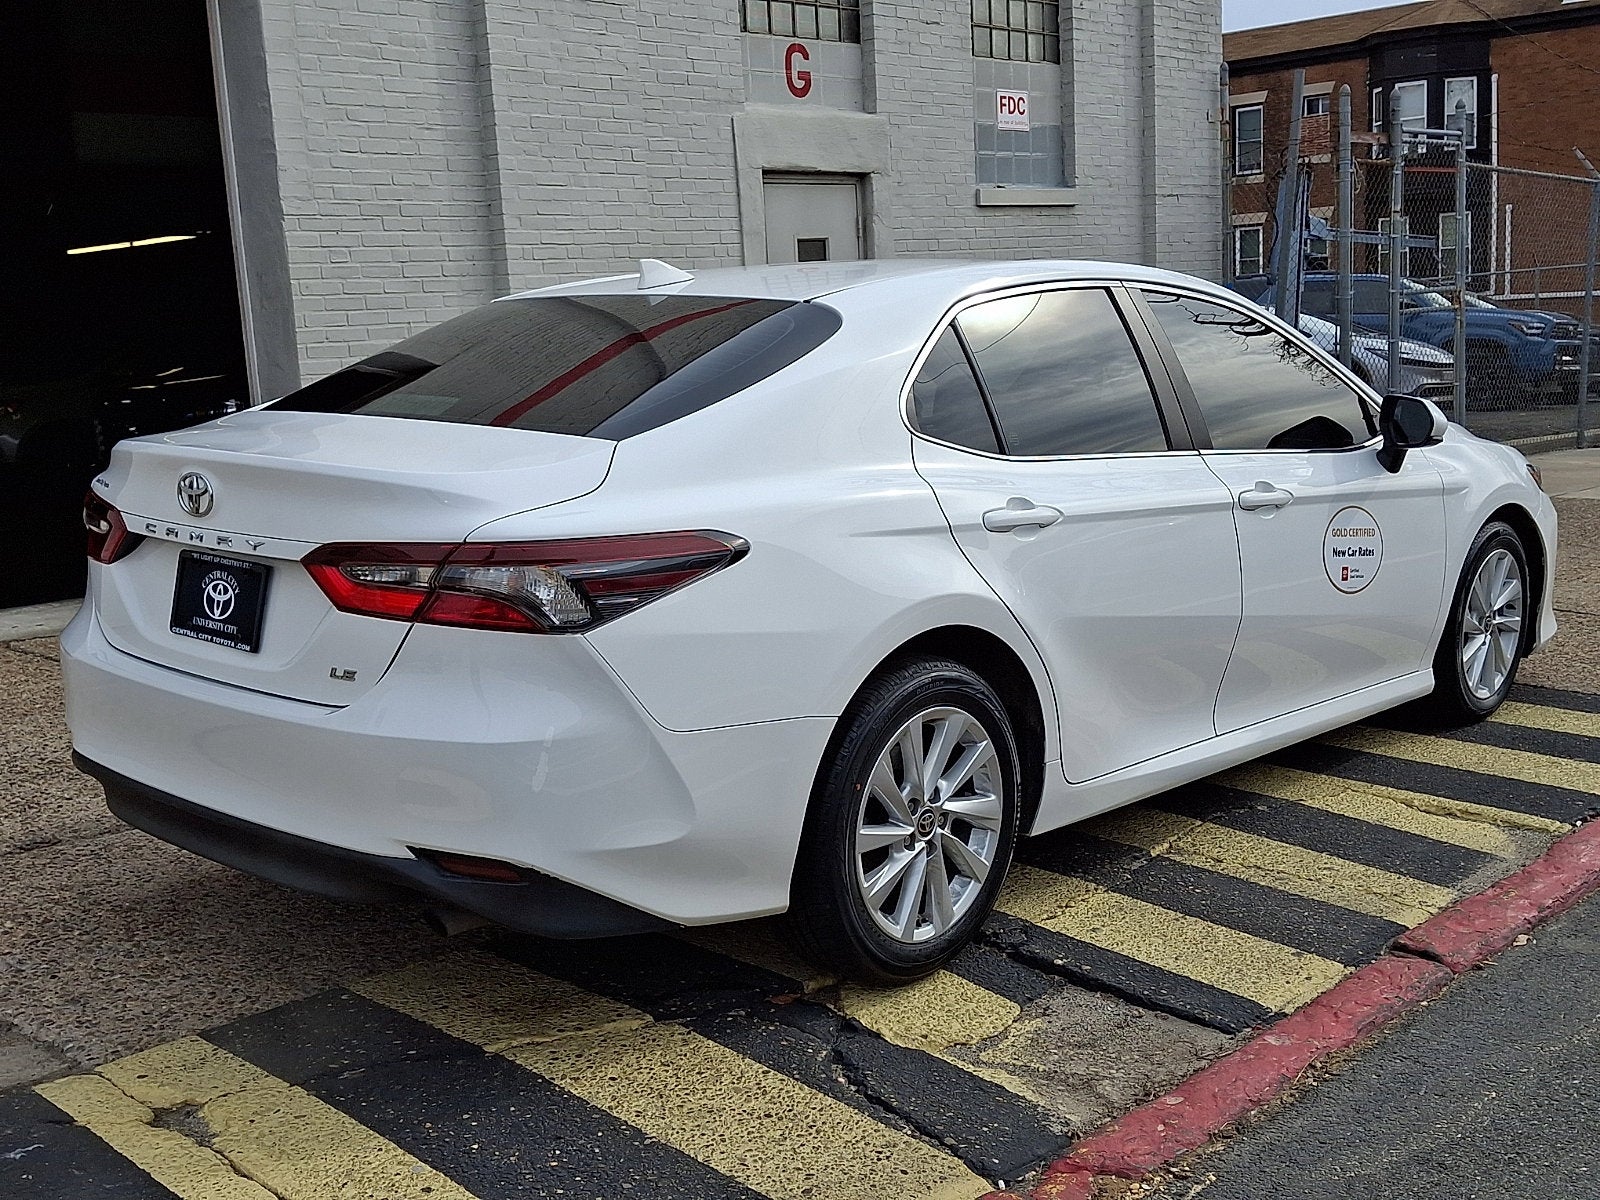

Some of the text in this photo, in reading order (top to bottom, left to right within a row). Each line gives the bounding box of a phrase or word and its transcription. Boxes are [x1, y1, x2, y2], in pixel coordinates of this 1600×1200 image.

[785, 43, 811, 98] G
[1000, 96, 1025, 115] FDC
[145, 523, 265, 551] CAMRY
[1332, 528, 1375, 537] GOLD CERTIFIED
[1333, 547, 1374, 557] New Car Rates
[202, 571, 240, 594] CENTRAL CITY
[193, 616, 238, 634] UNIVERSITY CITY
[172, 627, 197, 638] CENTRAL
[198, 633, 212, 641] CITY
[213, 637, 235, 647] TOYOTA
[330, 667, 357, 681] LE
